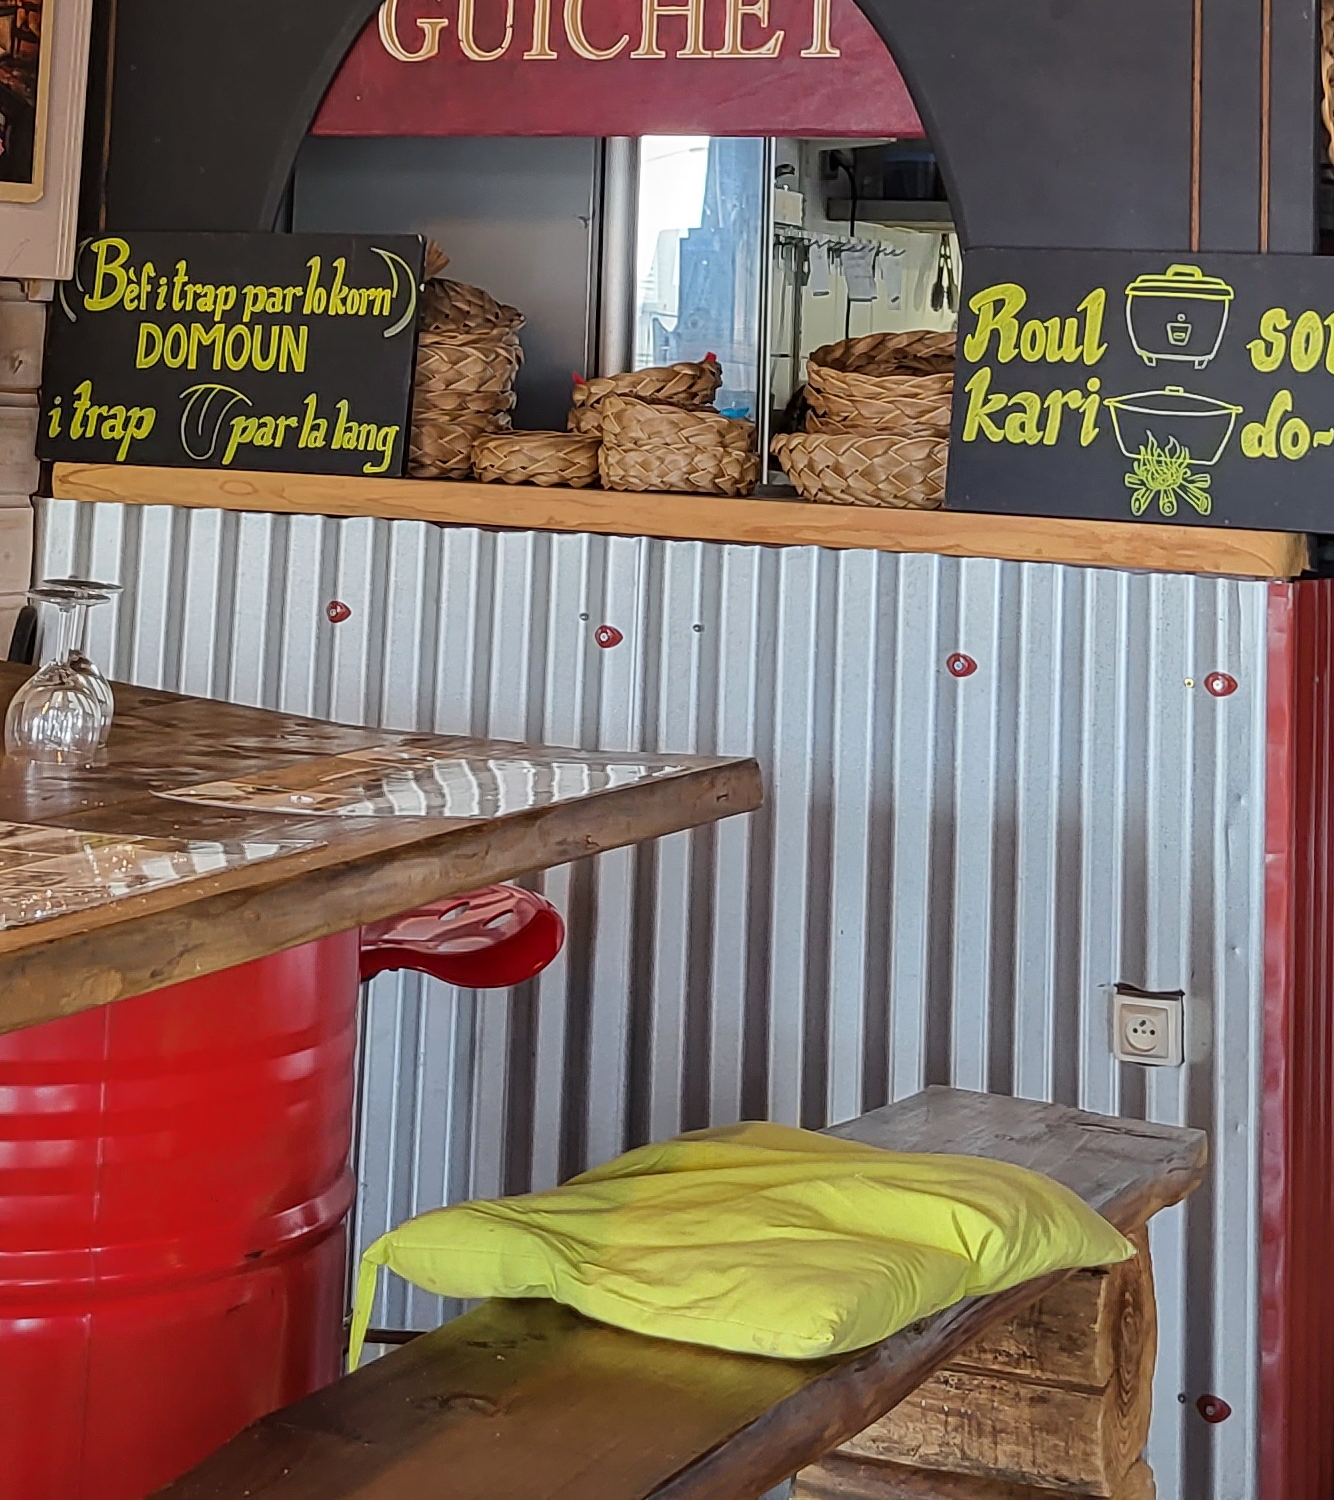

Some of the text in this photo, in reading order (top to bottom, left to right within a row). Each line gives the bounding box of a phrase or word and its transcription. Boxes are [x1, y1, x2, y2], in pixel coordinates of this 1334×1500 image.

[172, 259, 236, 322] trap
[243, 283, 303, 323] par
[329, 257, 394, 317] korn
[963, 282, 1108, 366] Roul
[135, 322, 309, 373] DOMOUN
[47, 379, 400, 474] i trap par la lang
[962, 366, 1102, 447] kari
